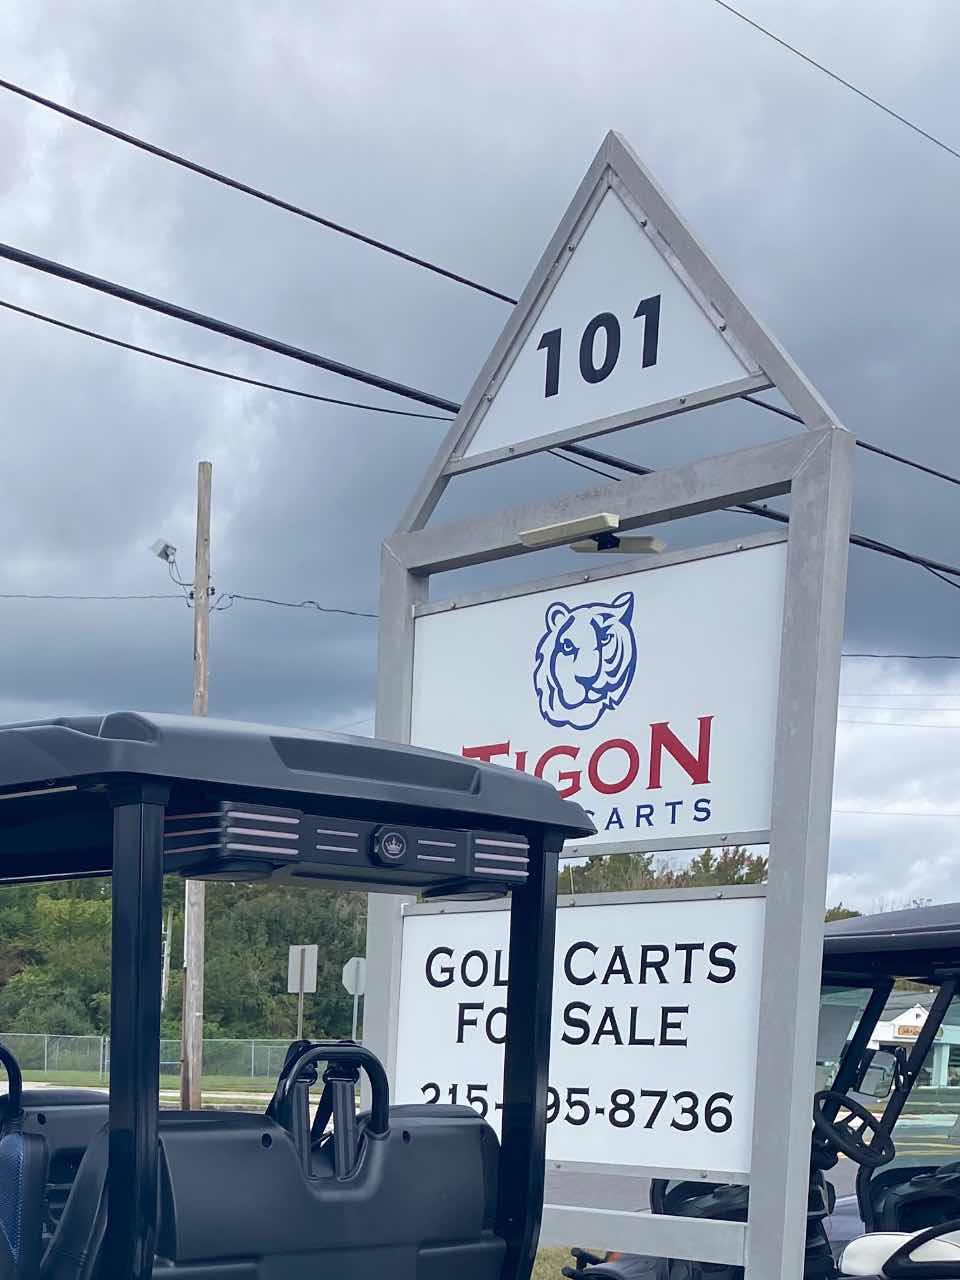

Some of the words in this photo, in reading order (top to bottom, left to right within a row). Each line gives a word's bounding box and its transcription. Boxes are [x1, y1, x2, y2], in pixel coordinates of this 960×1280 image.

[536, 295, 662, 398] 101
[586, 798, 712, 831] ARTS
[425, 946, 509, 988] GOL
[564, 941, 738, 986] CARTS
[456, 1000, 508, 1044] FO
[561, 1001, 689, 1047] SALE
[421, 1082, 734, 1133] 215-95-8736
